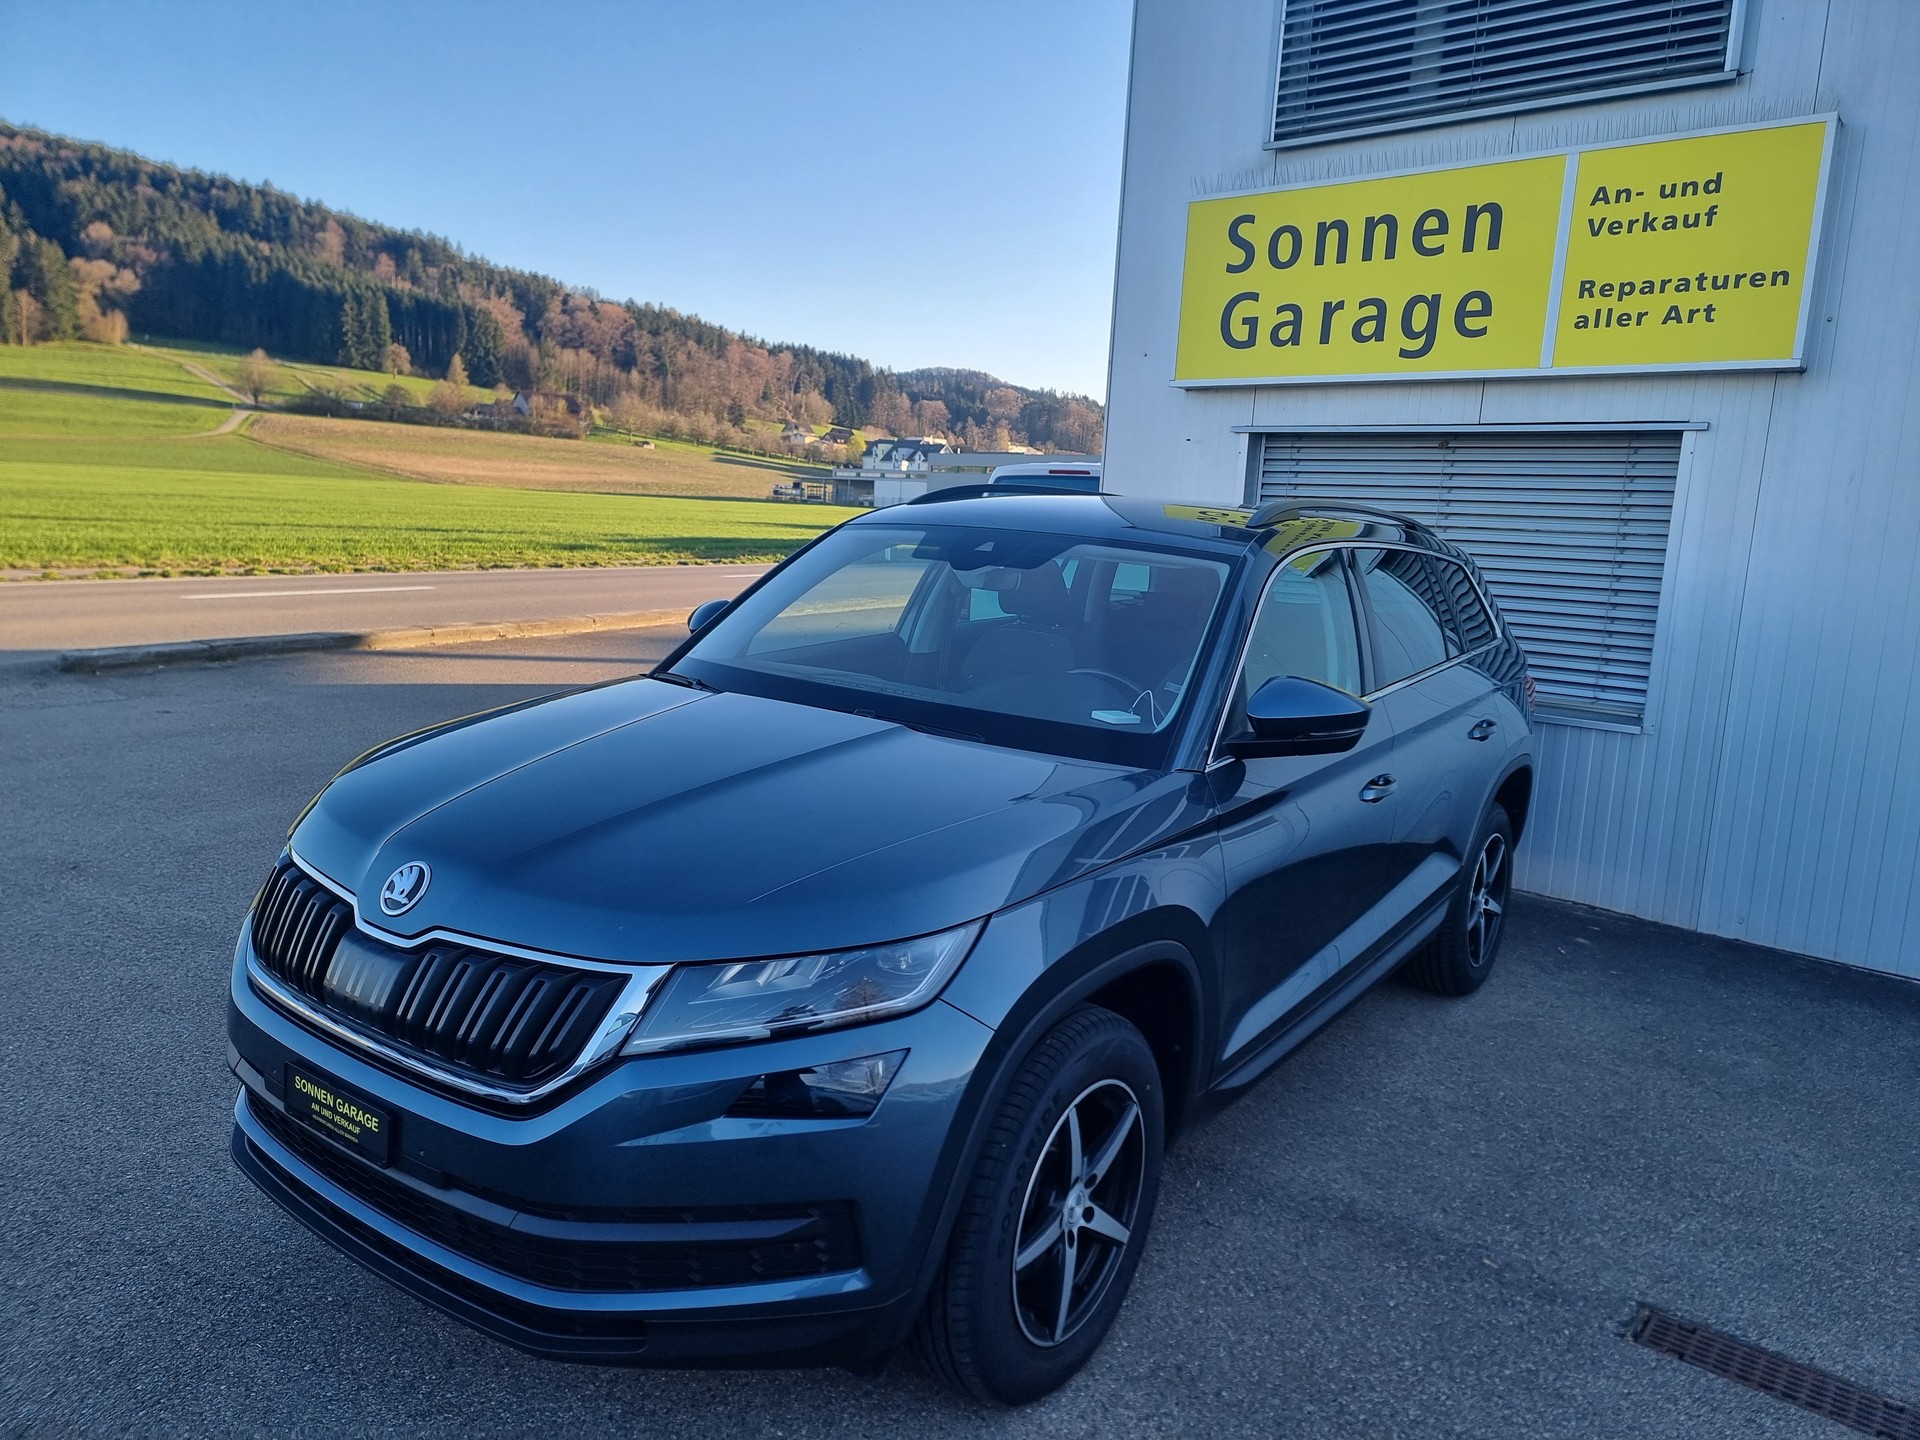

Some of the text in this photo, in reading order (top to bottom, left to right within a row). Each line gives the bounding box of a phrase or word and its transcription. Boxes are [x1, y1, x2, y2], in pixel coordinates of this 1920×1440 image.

[1589, 171, 1725, 208] An- und
[1225, 201, 1504, 275] Sonnen
[1587, 205, 1719, 238] Verkauf
[1577, 269, 1791, 303] Reparaturen
[1219, 289, 1493, 360] Garage
[1573, 302, 1717, 330] aller Art
[294, 1075, 334, 1108] SONNEN
[335, 1098, 379, 1132] GARAGE
[311, 1102, 320, 1113] AN
[320, 1107, 333, 1120] UND
[333, 1114, 361, 1135] VERKAUF
